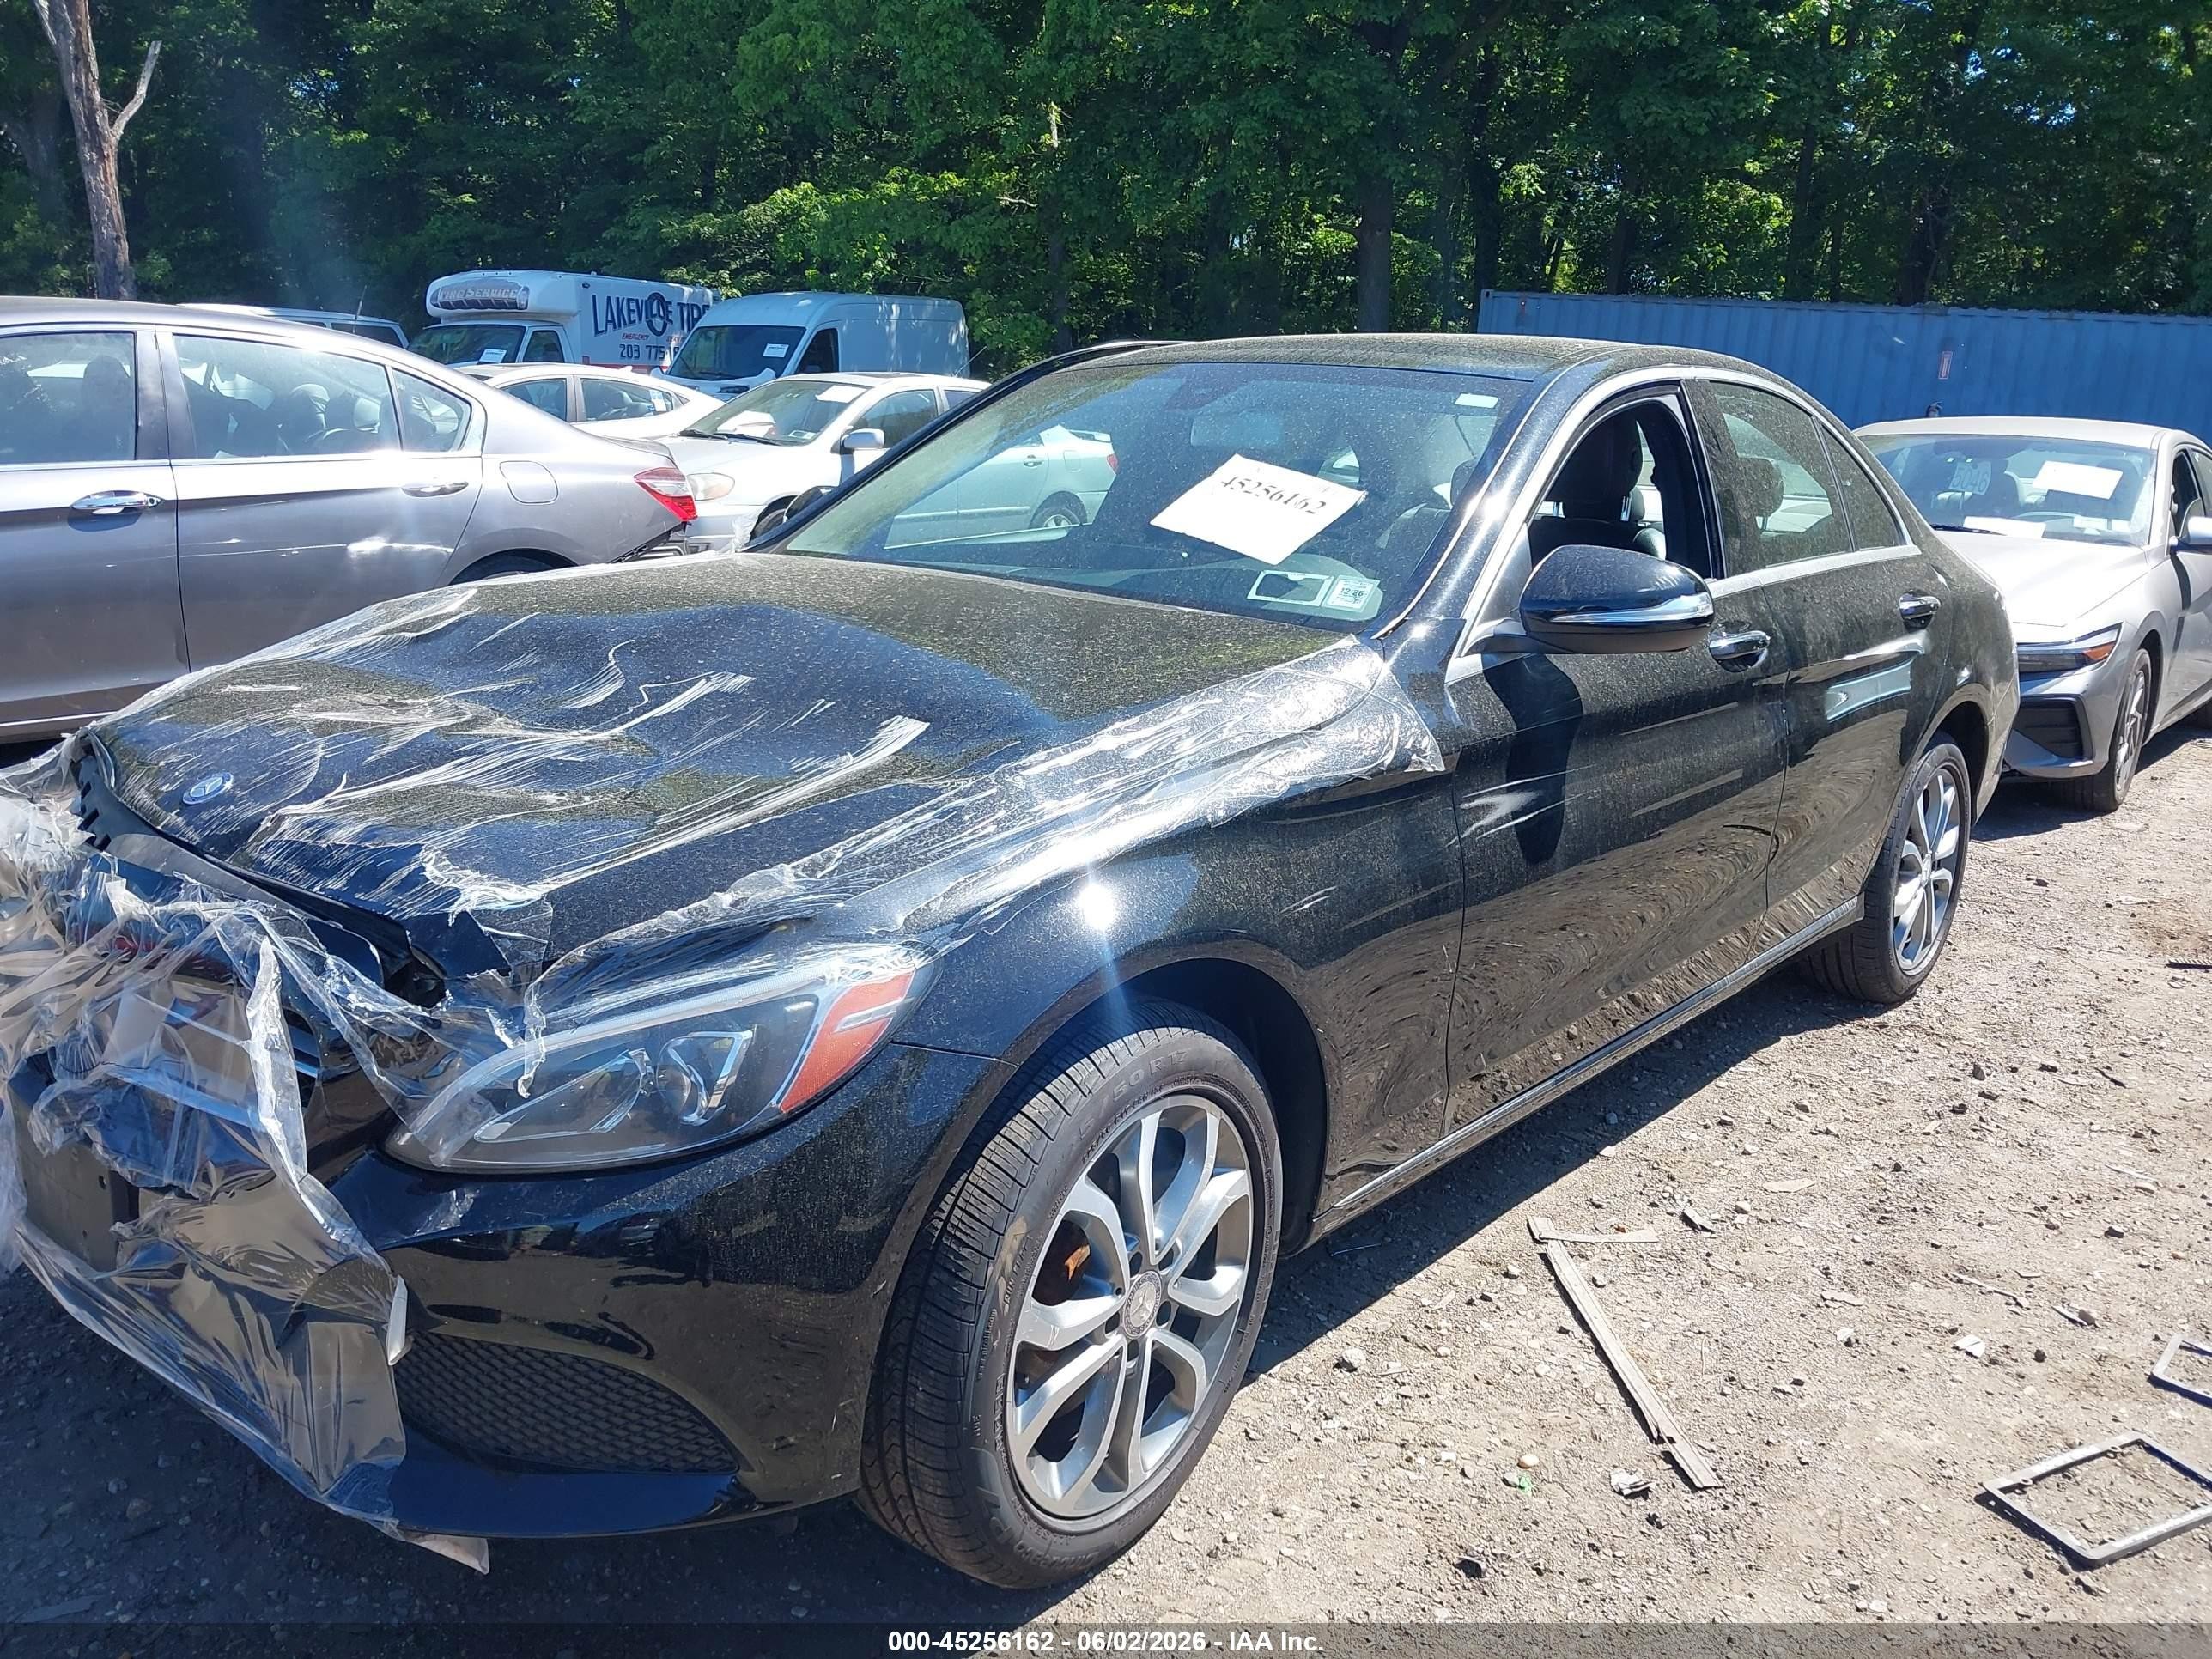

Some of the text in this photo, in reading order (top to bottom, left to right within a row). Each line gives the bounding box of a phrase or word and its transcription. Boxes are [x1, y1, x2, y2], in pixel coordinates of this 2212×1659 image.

[465, 289, 519, 299] SERVICE
[619, 343, 641, 359] 203
[1221, 475, 1328, 514] 45256162
